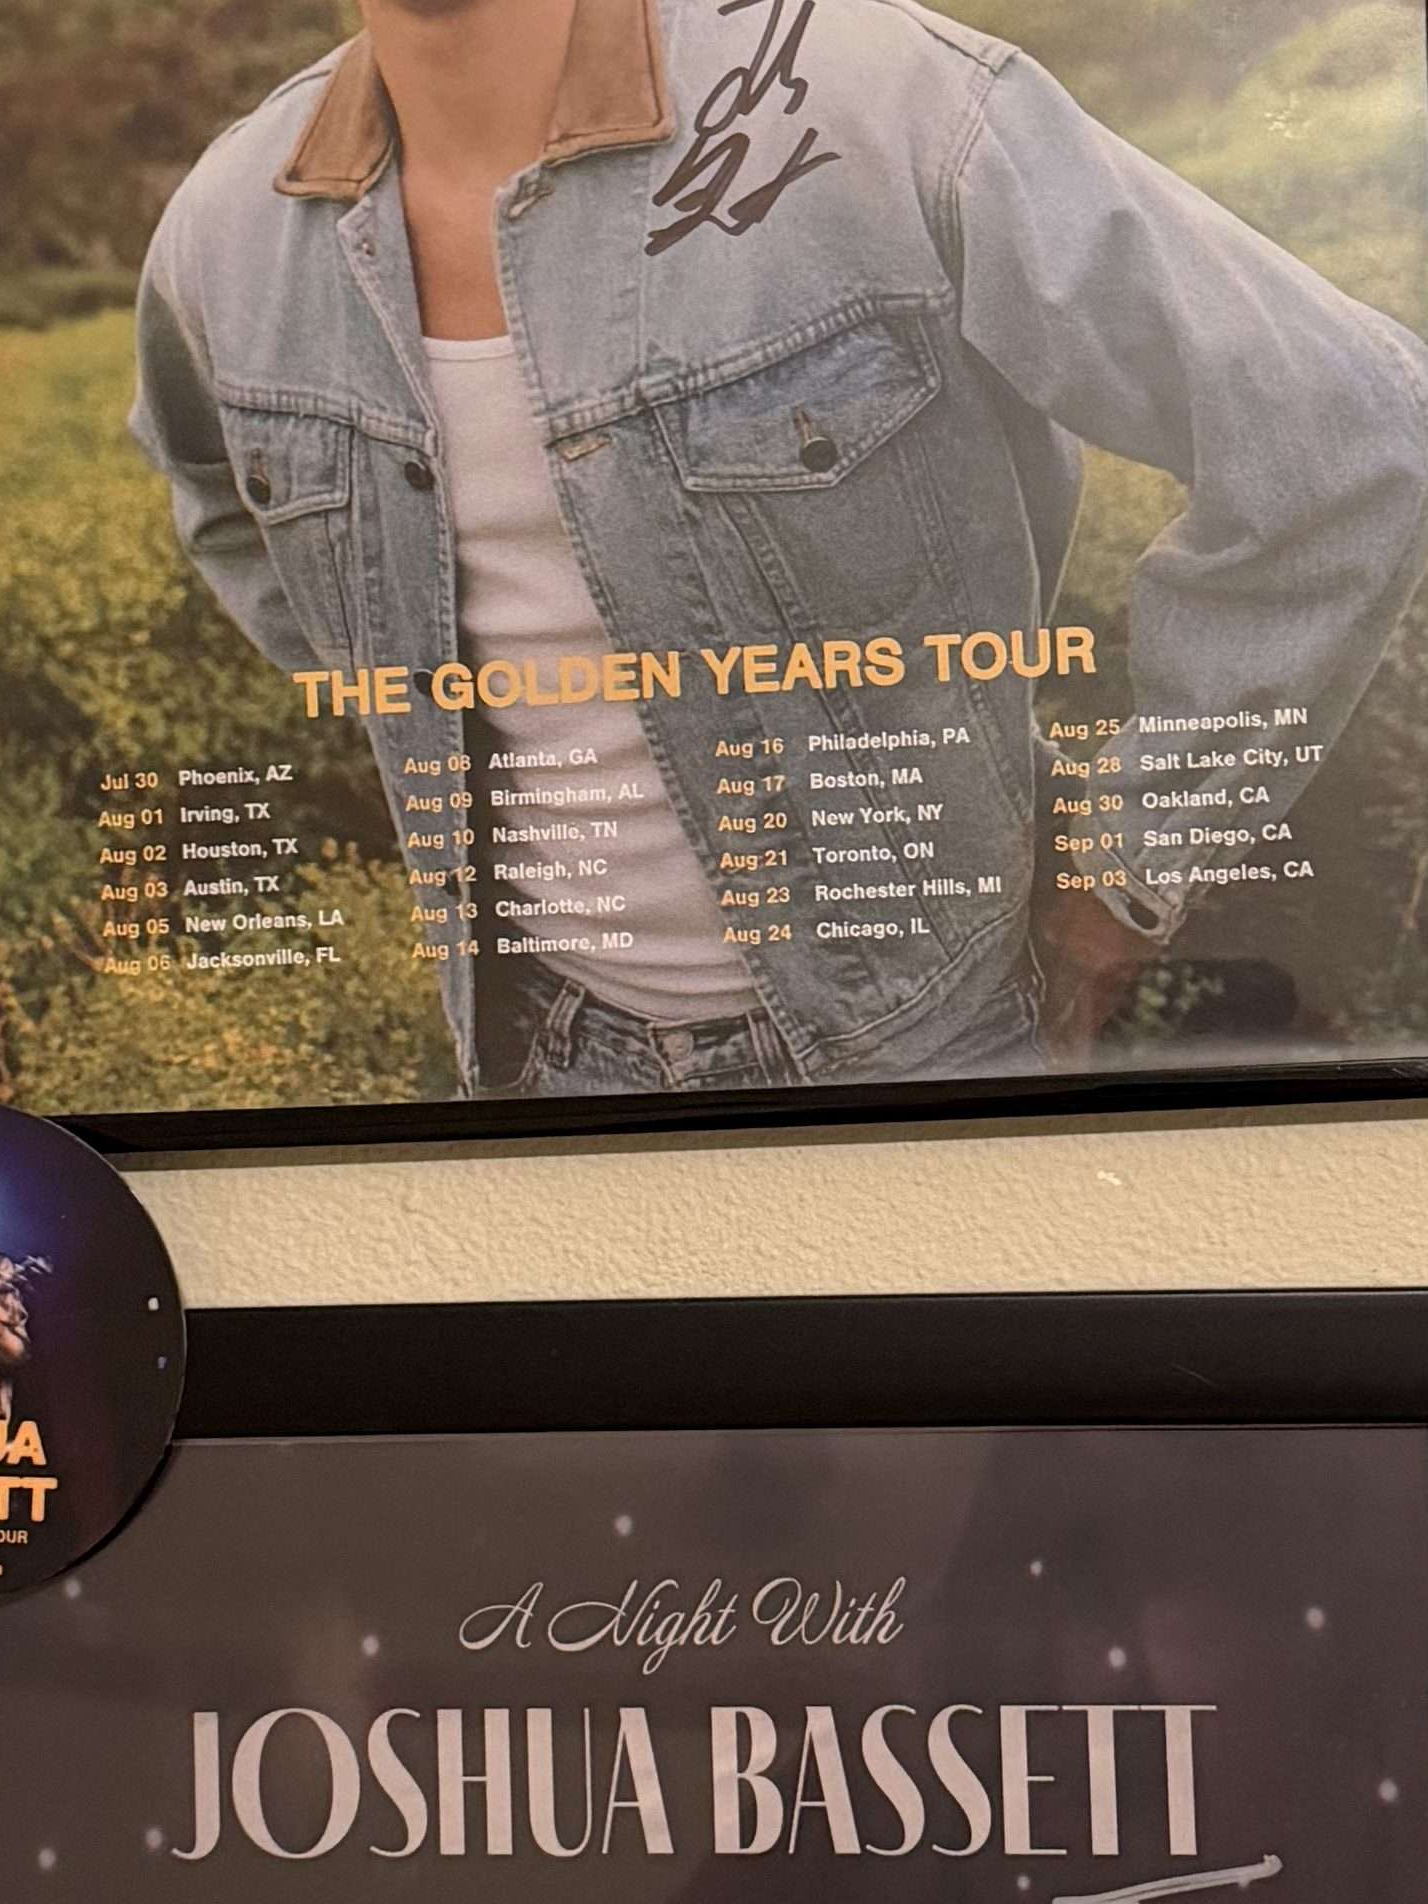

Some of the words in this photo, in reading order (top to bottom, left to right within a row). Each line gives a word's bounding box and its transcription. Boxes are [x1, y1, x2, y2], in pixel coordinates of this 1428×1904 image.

[293, 667, 411, 718] THE
[432, 651, 681, 712] GOLDEN
[702, 637, 904, 695] YEARS
[924, 627, 1097, 683] TOUR
[1050, 720, 1090, 742] Aug
[1094, 719, 1121, 737] 25
[1139, 710, 1268, 737] Minneapolis,
[1275, 708, 1308, 724] MN
[716, 739, 754, 760] Aug
[758, 737, 784, 755] 16
[808, 732, 937, 756] Philadelphia,
[942, 728, 970, 745] PA
[404, 757, 443, 778] Aug
[447, 755, 471, 772] 08
[488, 750, 563, 772] Atlanta,
[569, 748, 598, 766] GA
[1051, 758, 1091, 779] Aug
[1095, 757, 1122, 775] 28
[1140, 754, 1182, 772] Salt
[1187, 751, 1237, 770] Lake
[1244, 748, 1289, 770] City,
[1295, 745, 1323, 762] UT
[100, 773, 130, 792] Jul
[133, 771, 158, 789] 30
[179, 767, 261, 788] Phoenix,
[265, 764, 293, 782] AZ
[717, 776, 756, 798] Aug
[759, 775, 785, 793] 17
[810, 771, 886, 791] Boston,
[892, 768, 923, 785] MA
[405, 794, 444, 816] Aug
[449, 792, 472, 809] 09
[490, 784, 616, 807] Birmingham,
[620, 783, 644, 800] AL
[1052, 796, 1092, 817] Aug
[1096, 795, 1123, 812] 30
[1142, 789, 1233, 810] Oakland,
[1239, 786, 1270, 804] CA
[98, 810, 138, 831] Aug
[141, 809, 164, 826] 01
[180, 806, 240, 826] Irving,
[244, 803, 270, 820] TX
[718, 813, 757, 835] Aug
[761, 812, 788, 830] 20
[812, 809, 854, 827] New
[858, 806, 914, 826] York,
[918, 803, 944, 820] NY
[100, 847, 139, 867] Aug
[143, 845, 167, 862] 02
[182, 840, 267, 861] Houston,
[272, 838, 298, 856] TX
[407, 831, 446, 853] Aug
[450, 829, 474, 847] 10
[492, 823, 585, 845] Nashville,
[589, 821, 617, 839] TN
[1054, 834, 1094, 855] Sep
[1099, 832, 1124, 850] 01
[1144, 830, 1182, 848] San
[1187, 827, 1257, 849] Diego,
[1262, 825, 1293, 842] CA
[720, 850, 758, 872] Aug
[762, 849, 788, 866] 21
[813, 845, 898, 865] Toronto,
[903, 843, 934, 859] ON
[409, 868, 448, 889] Aug
[452, 866, 477, 883] 12
[494, 861, 573, 884] Raleigh,
[578, 858, 608, 876] NC
[1056, 872, 1096, 893] Sep
[1100, 870, 1127, 888] 03
[1146, 868, 1182, 885] Los
[1187, 864, 1278, 887] Angeles,
[1284, 861, 1314, 879] CA
[101, 884, 140, 904] Aug
[144, 882, 168, 898] 03
[183, 878, 249, 898] Austin,
[254, 876, 280, 893] TX
[721, 888, 759, 909] Aug
[763, 886, 790, 904] 23
[815, 880, 918, 902] Rochester
[923, 878, 973, 899] Hills,
[978, 876, 1002, 893] MI
[103, 920, 141, 940] Aug
[145, 919, 170, 935] 05
[185, 916, 225, 934] New
[229, 914, 313, 933] Orleans,
[318, 911, 344, 928] LA
[410, 904, 449, 926] Aug
[453, 903, 478, 920] 13
[495, 898, 591, 919] Charlotte,
[596, 895, 626, 913] NC
[411, 942, 450, 963] Aug
[454, 940, 480, 957] 14
[497, 935, 595, 955] Baltimore,
[602, 932, 633, 950] MD
[723, 925, 762, 947] Aug
[765, 924, 792, 942] 24
[816, 920, 906, 942] Chicago,
[910, 918, 930, 934] IL
[104, 956, 143, 976] Aug
[147, 955, 171, 971] 06
[186, 948, 309, 971] Jacksonville,
[316, 947, 340, 964] FL
[458, 1580, 547, 1651] A
[547, 1590, 737, 1675] Night
[751, 1577, 907, 1651] With
[173, 1705, 674, 1860] JOSHUA
[711, 1703, 1218, 1857] BASSETT
